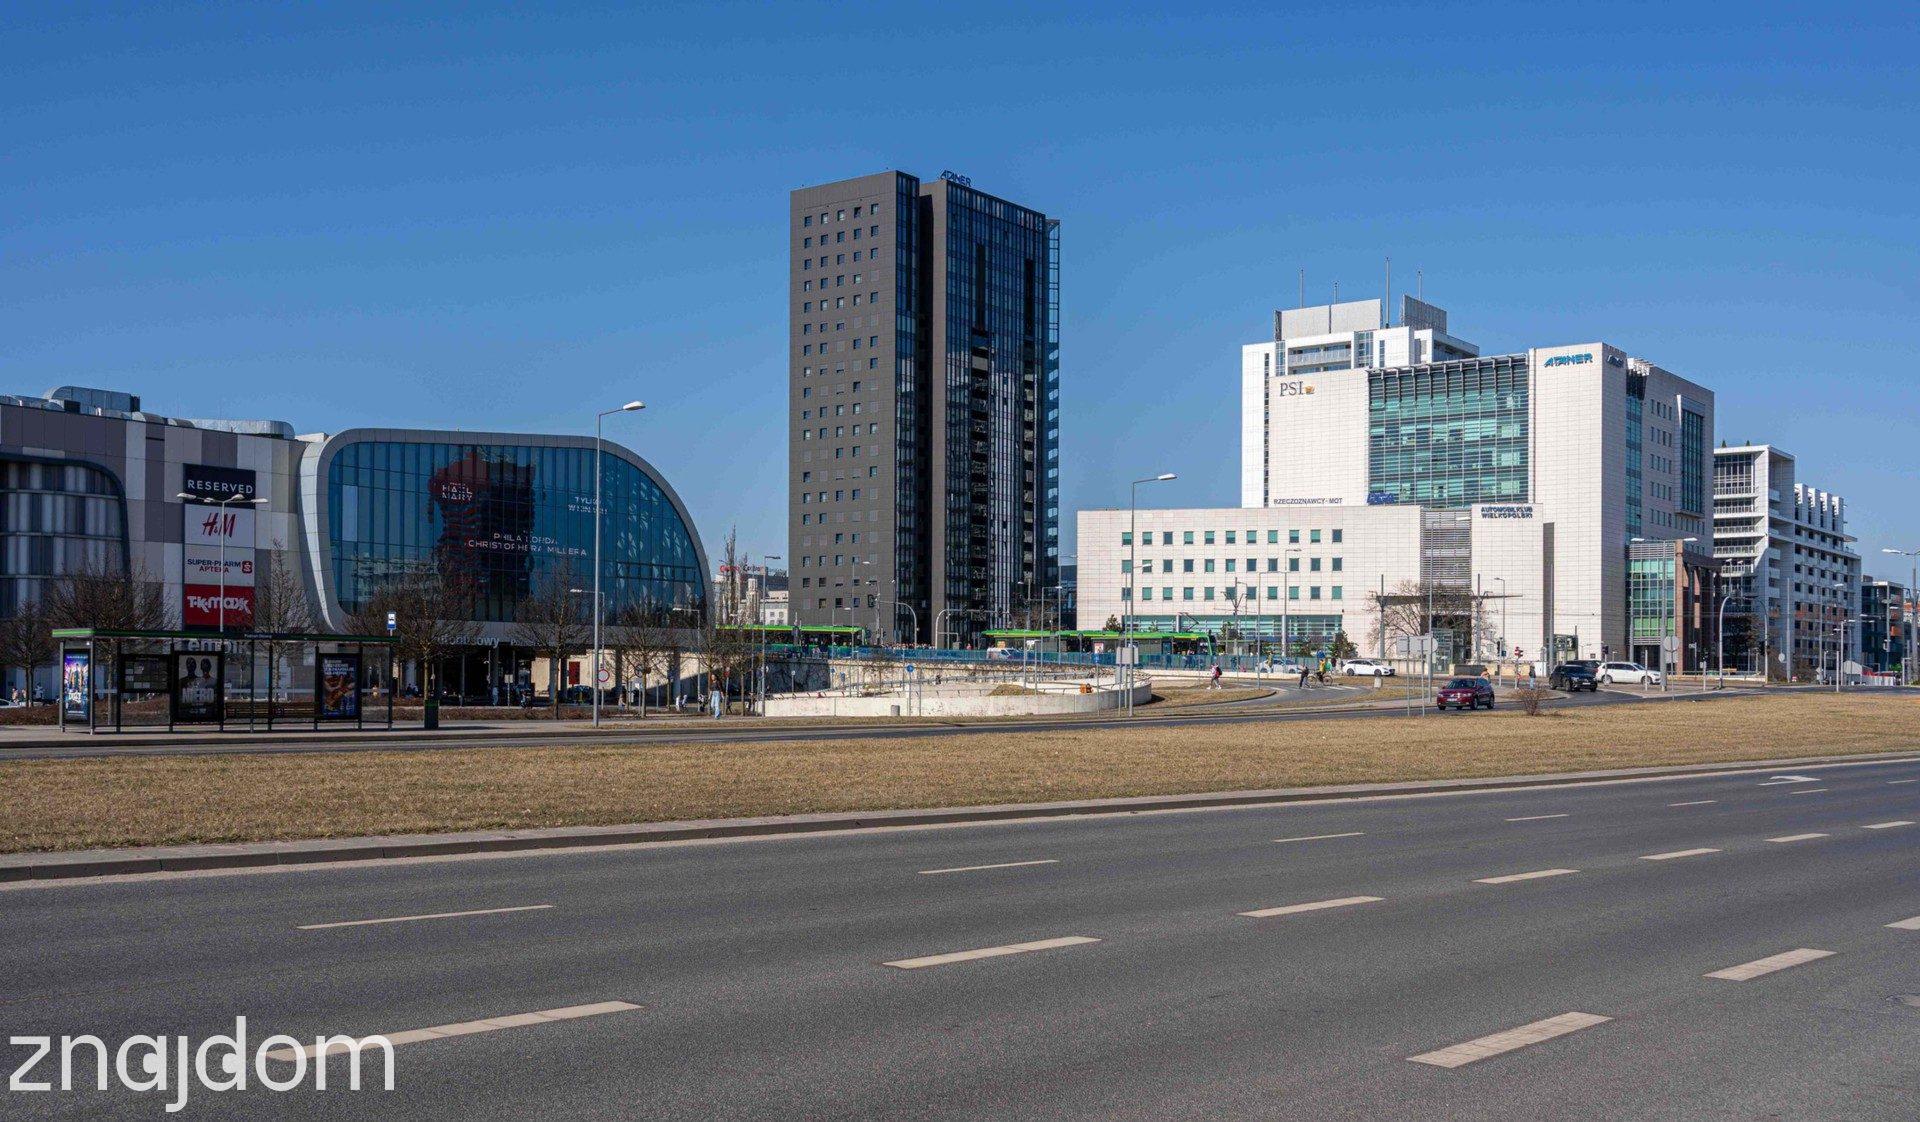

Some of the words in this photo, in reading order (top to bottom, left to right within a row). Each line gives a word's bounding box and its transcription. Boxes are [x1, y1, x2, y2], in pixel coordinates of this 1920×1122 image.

[1280, 380, 1304, 397] PSI
[187, 479, 253, 494] RESERVED
[202, 512, 236, 538] H&M
